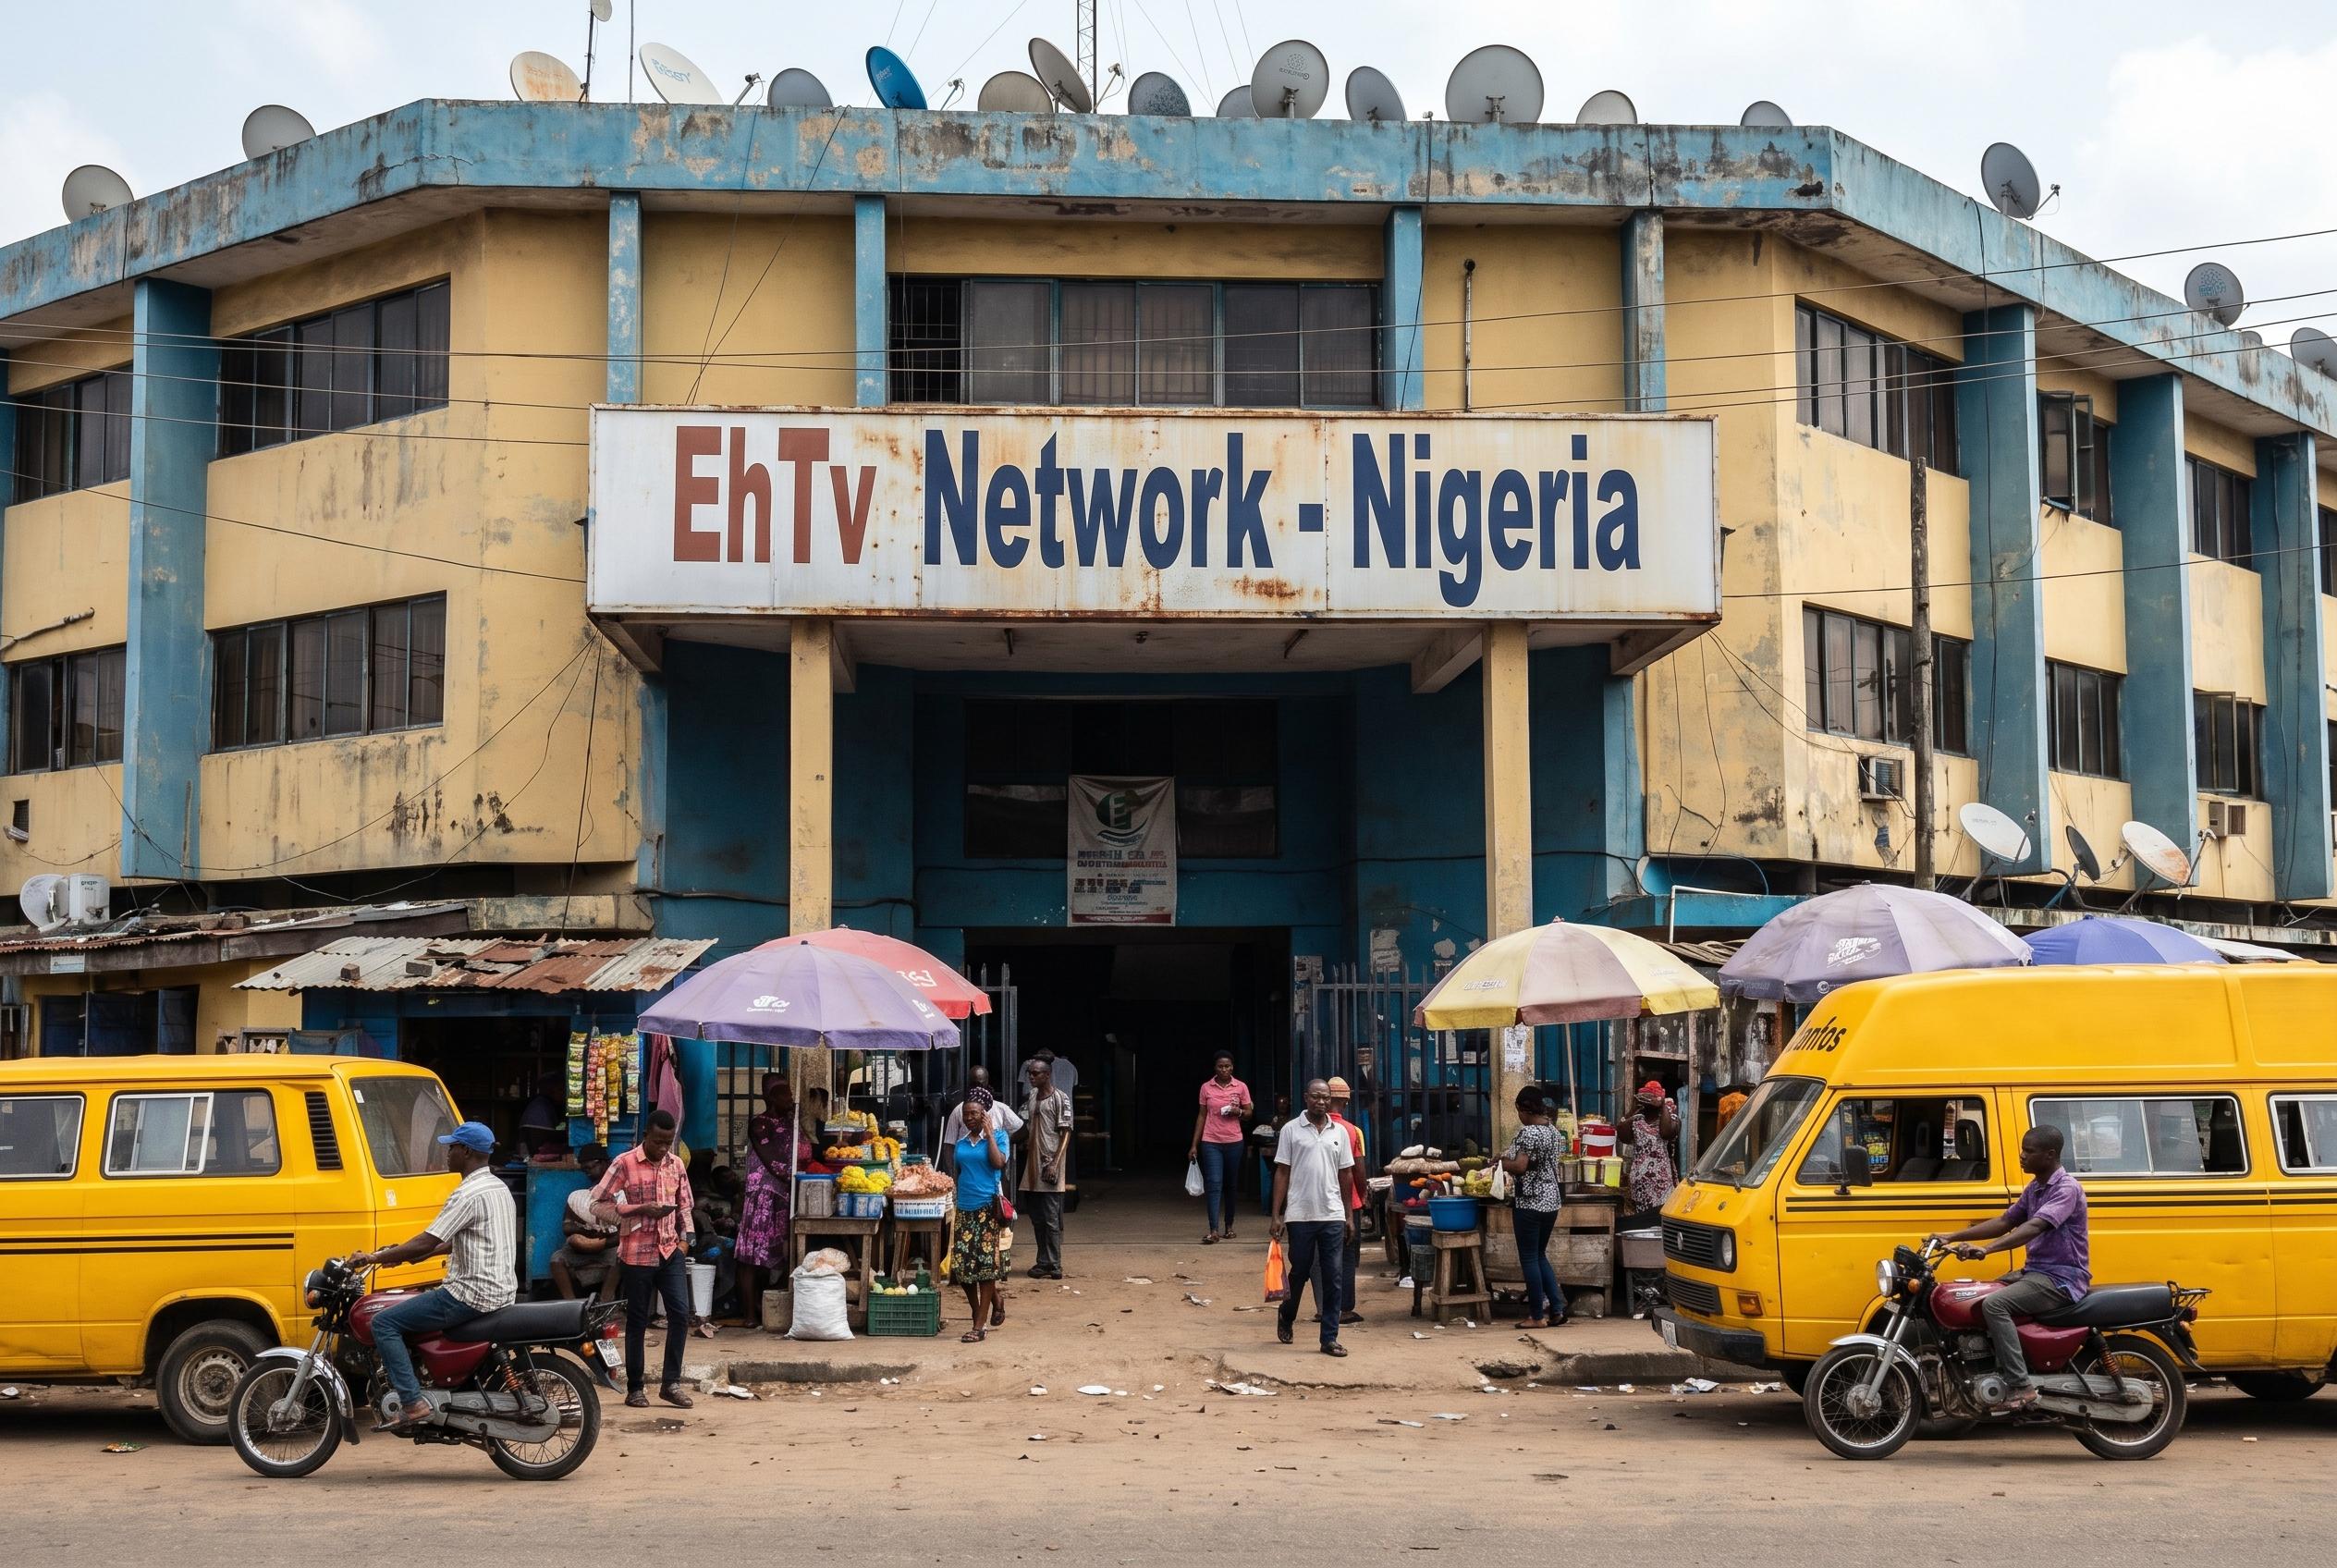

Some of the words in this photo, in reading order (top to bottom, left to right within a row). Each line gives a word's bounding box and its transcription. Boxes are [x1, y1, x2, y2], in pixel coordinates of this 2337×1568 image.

[673, 425, 877, 565] EhTv
[924, 429, 1274, 570] Network
[1298, 503, 1324, 533] -
[1352, 433, 1642, 608] Nigeria
